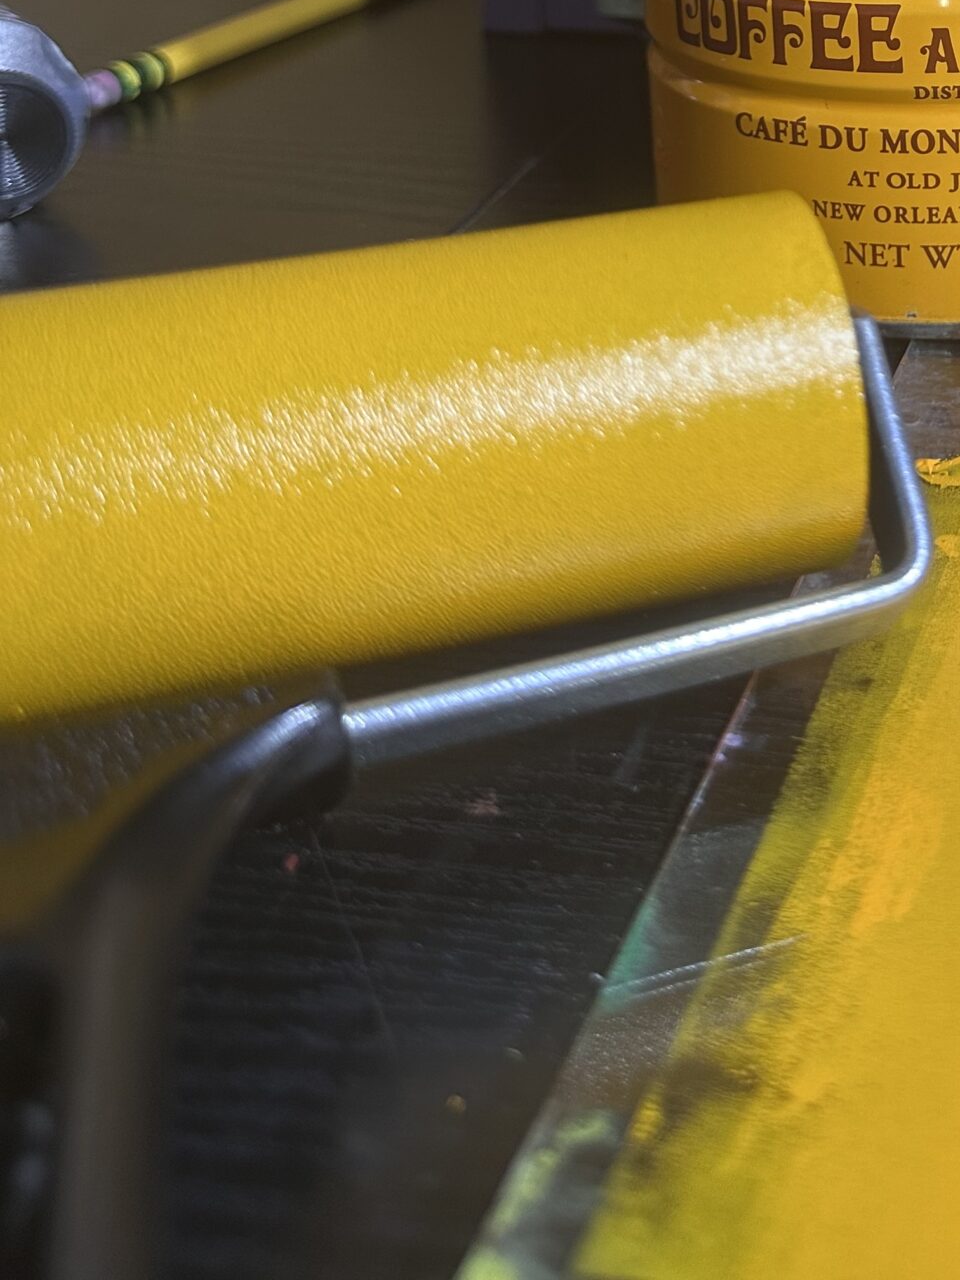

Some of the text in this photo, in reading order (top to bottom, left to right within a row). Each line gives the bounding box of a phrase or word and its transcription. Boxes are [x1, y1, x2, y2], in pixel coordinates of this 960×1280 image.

[735, 112, 808, 147] CAFÉ
[818, 124, 868, 152] DU
[847, 170, 880, 188] AT
[886, 172, 941, 189] OLD
[812, 199, 866, 221] NEW
[843, 241, 910, 268] NET
